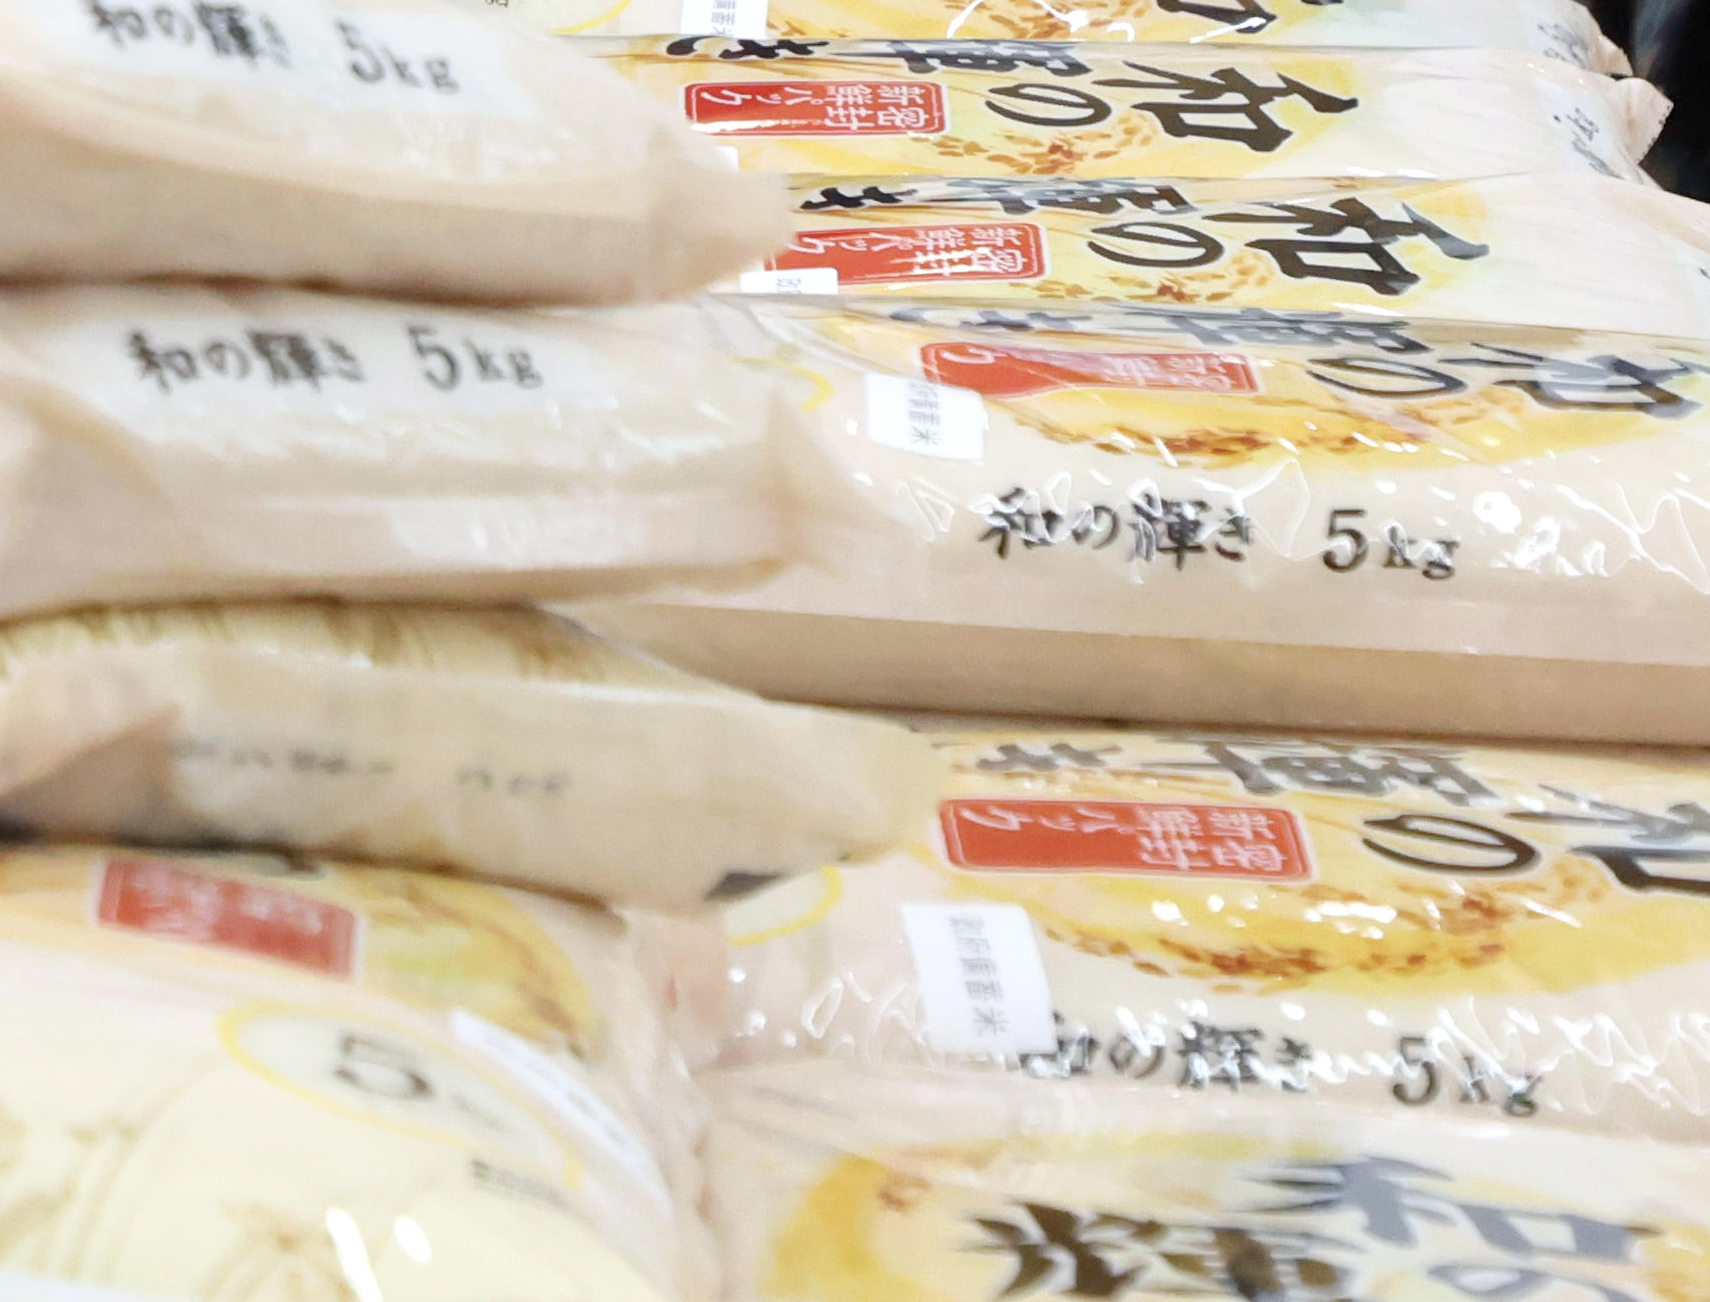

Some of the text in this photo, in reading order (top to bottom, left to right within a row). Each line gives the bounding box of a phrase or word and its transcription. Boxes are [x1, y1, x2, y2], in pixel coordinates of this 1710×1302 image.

[336, 19, 459, 92] 5kg
[701, 83, 926, 107] 新鮮パック
[985, 60, 1359, 152] 和の
[1087, 198, 1489, 295] 和の
[128, 322, 543, 394] 和の輝き 5kg
[1323, 507, 1462, 581] 5kg
[1392, 1035, 1545, 1117] 5kg
